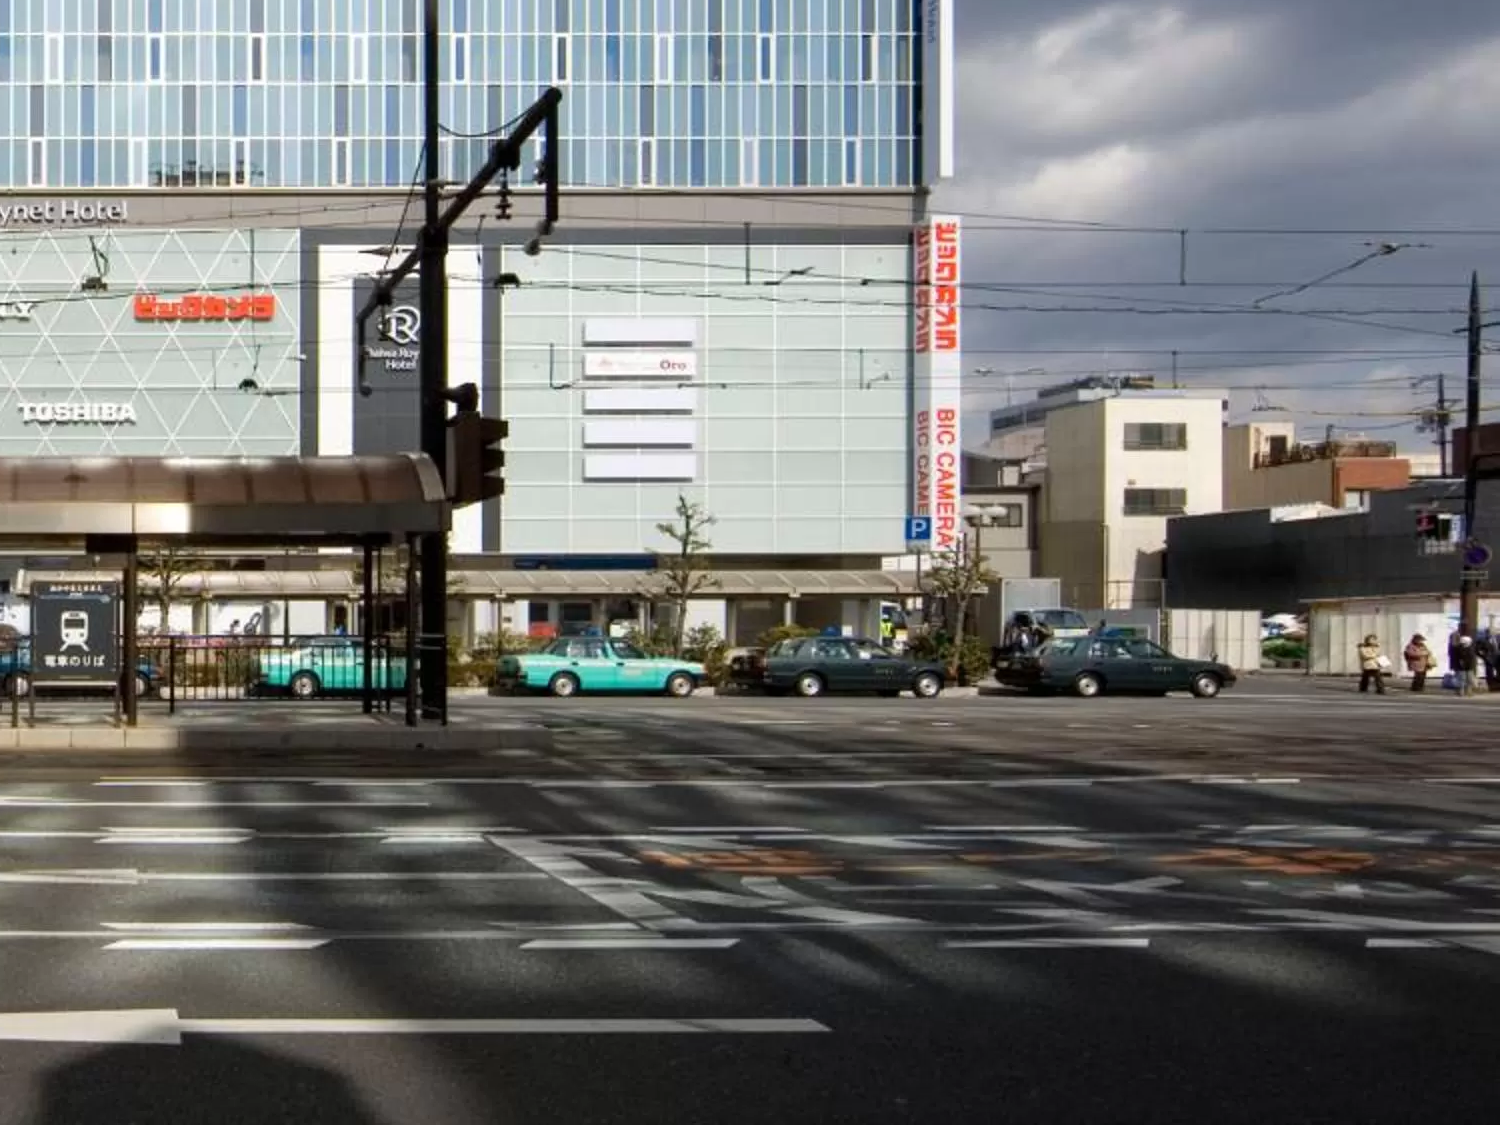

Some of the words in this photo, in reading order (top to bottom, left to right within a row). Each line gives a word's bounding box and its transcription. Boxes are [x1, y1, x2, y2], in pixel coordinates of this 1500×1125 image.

[60, 198, 129, 223] Hotel
[935, 222, 958, 350] ビックカメラ
[18, 402, 137, 425] TOSHIBA
[916, 410, 930, 447] BIC
[936, 408, 956, 445] BIC
[916, 455, 930, 516] CAME
[936, 452, 956, 547] CAMERA
[911, 518, 927, 538] P
